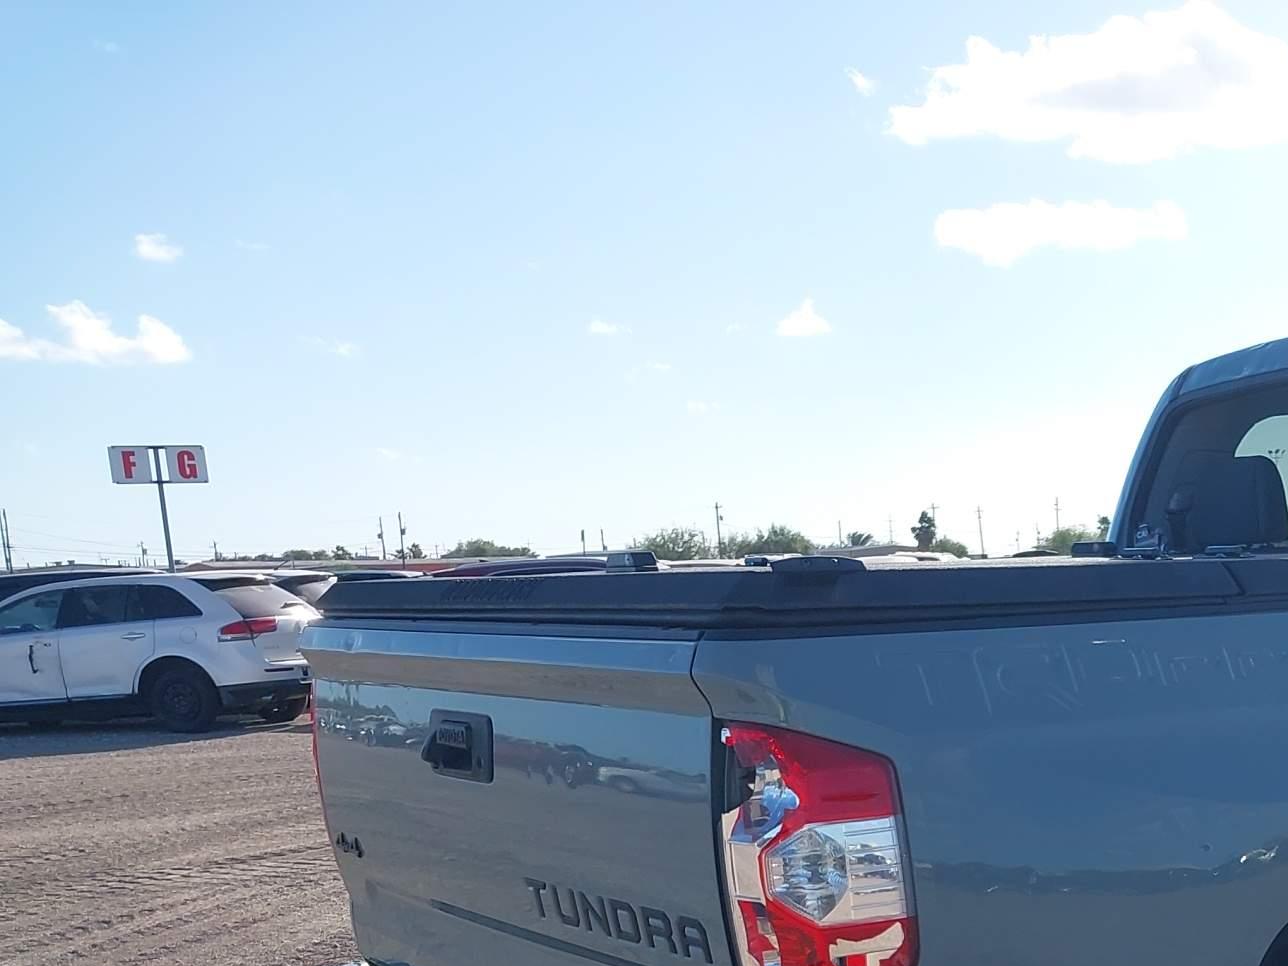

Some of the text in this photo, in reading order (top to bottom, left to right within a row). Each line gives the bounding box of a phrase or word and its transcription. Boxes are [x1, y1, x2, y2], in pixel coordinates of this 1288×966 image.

[121, 450, 198, 479] F G
[525, 877, 714, 965] TUNDRA
